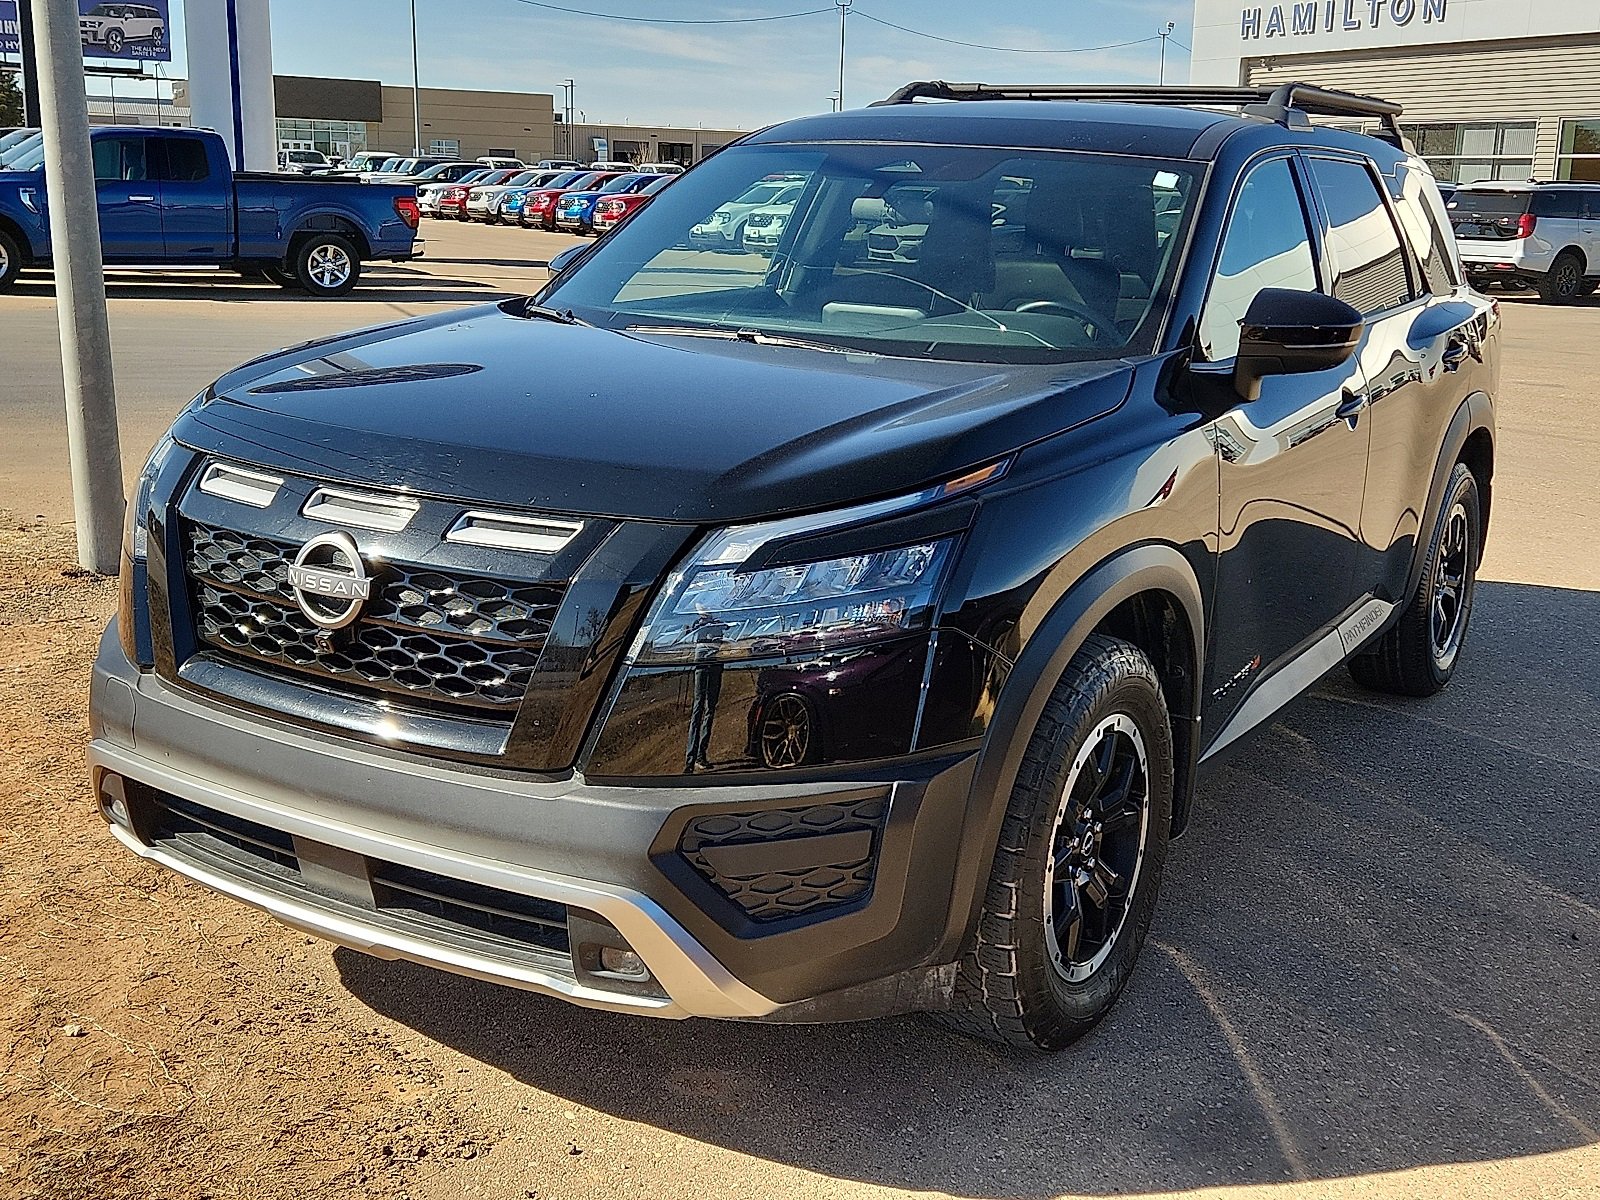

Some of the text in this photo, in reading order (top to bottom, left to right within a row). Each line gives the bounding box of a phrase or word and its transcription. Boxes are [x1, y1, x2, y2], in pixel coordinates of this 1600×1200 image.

[1240, 0, 1448, 40] HAMILTON
[288, 568, 367, 597] NISSAN
[1343, 603, 1385, 645] PATHFINDER
